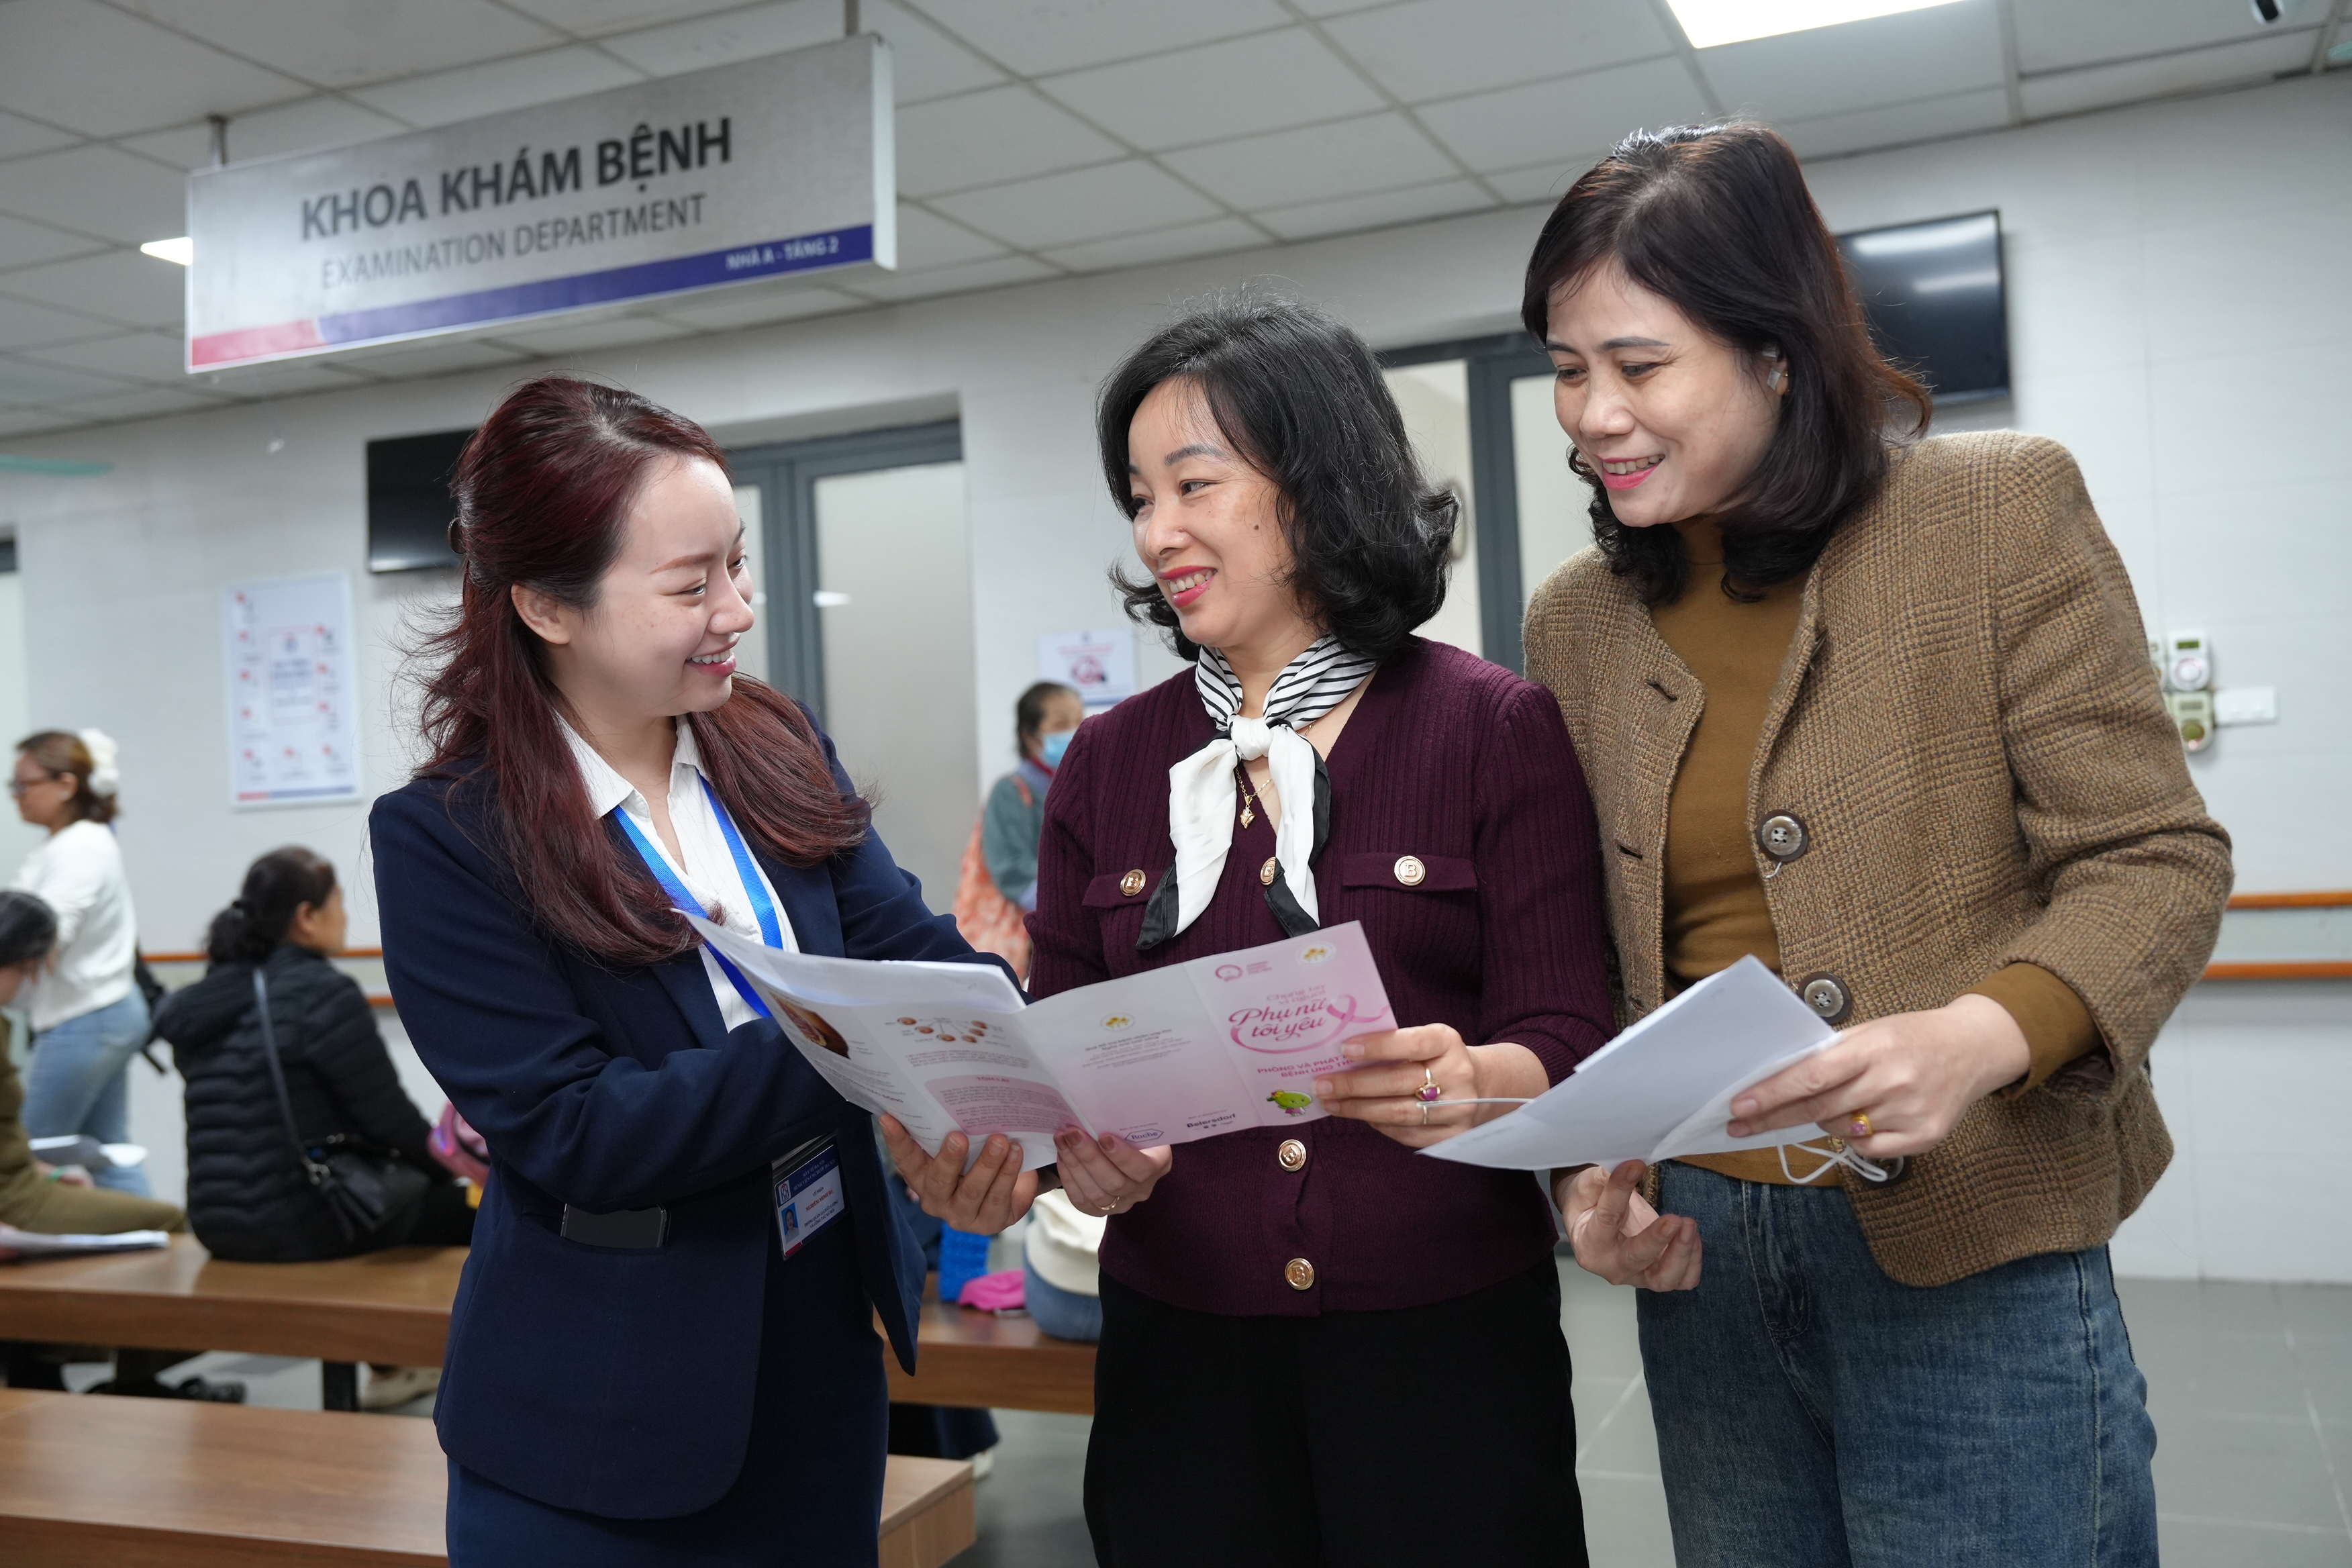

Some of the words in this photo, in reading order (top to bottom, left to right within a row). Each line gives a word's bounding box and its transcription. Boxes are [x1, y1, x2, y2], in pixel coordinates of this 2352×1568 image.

[303, 179, 428, 240] KHOA
[440, 145, 581, 215] KHÁM
[598, 116, 730, 192] BỆNH
[322, 230, 504, 290] EXAMINATION
[514, 192, 706, 256] DEPARTMENT
[828, 236, 838, 254] 2
[1404, 863, 1416, 877] B
[1228, 1006, 1292, 1026] Phụ
[1295, 997, 1328, 1016] nữ
[1252, 1024, 1282, 1037] tôi
[1275, 1017, 1327, 1041] yêu
[1257, 1063, 1294, 1073] PHÒNG
[1314, 1056, 1341, 1066] PHÁT
[1281, 1069, 1309, 1077] BỆNH
[1187, 1113, 1236, 1128] Beiersdorf
[1131, 1131, 1159, 1140] Roche
[1291, 1266, 1306, 1282] B
